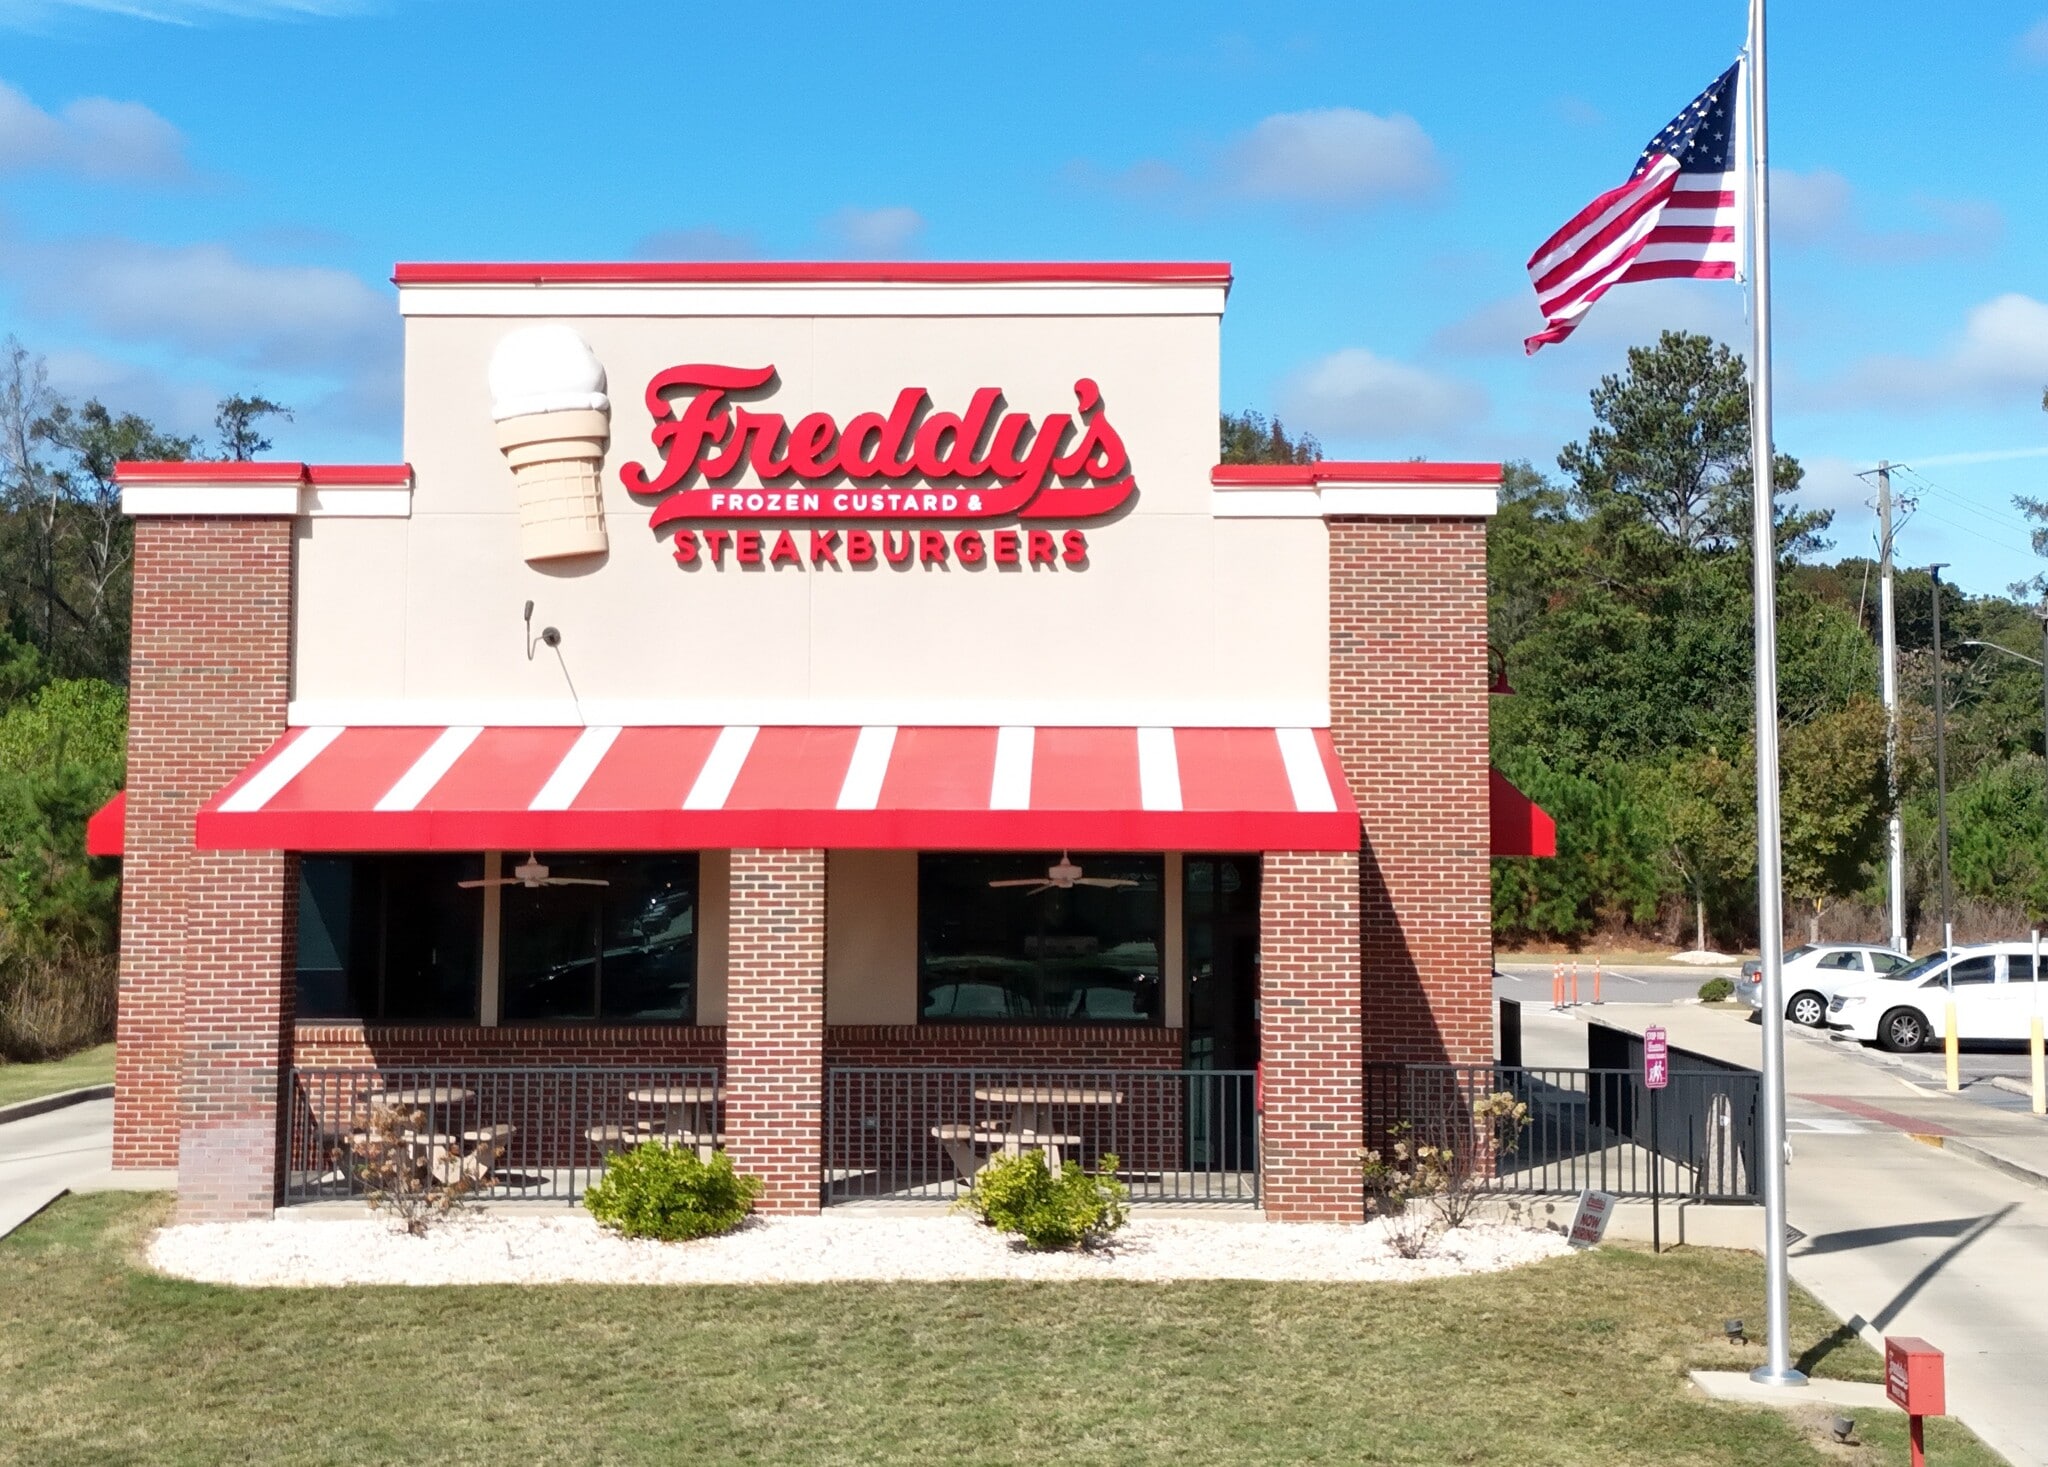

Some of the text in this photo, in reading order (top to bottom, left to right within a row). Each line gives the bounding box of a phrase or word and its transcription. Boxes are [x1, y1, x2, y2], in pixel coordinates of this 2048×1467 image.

[619, 363, 1134, 522] Freddy's
[711, 493, 983, 511] FROZEN CUSTARD &
[672, 528, 1087, 564] STEAKBURGERS
[1580, 1213, 1602, 1230] NOW
